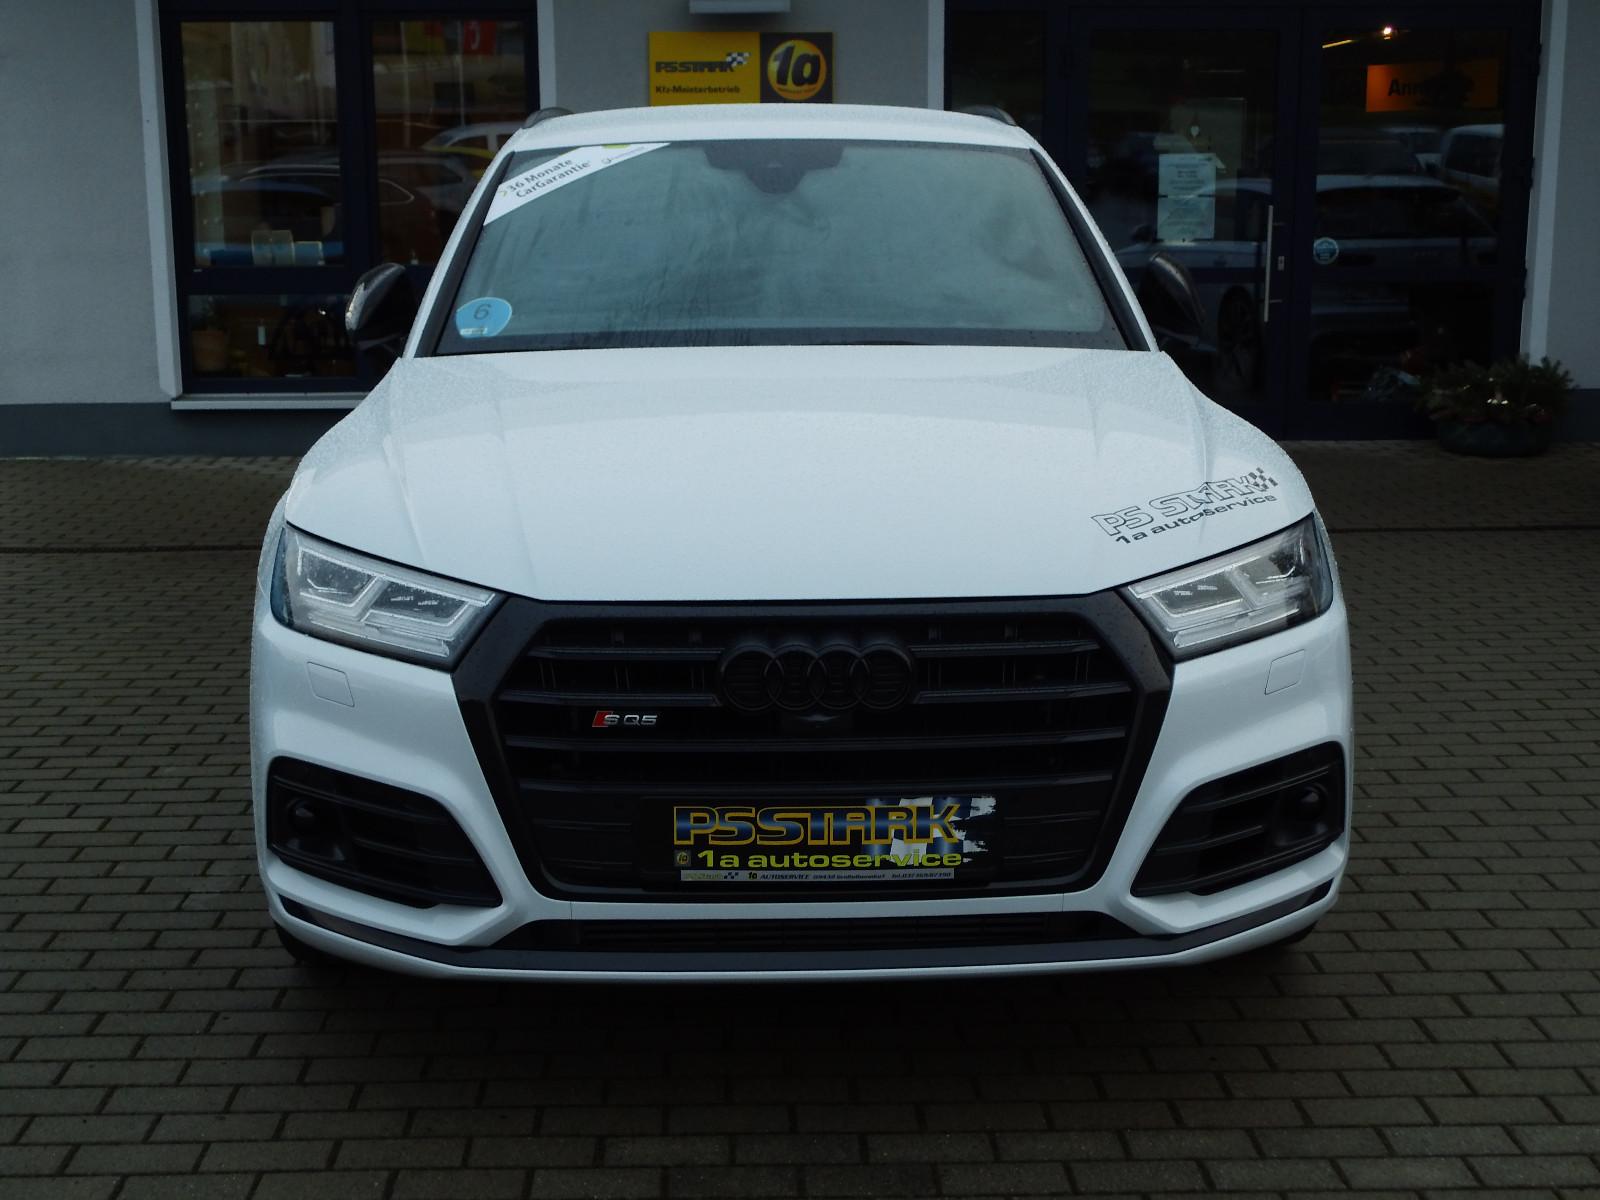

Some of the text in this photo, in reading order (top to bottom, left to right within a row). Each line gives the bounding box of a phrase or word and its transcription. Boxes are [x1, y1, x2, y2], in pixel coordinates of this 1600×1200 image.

[774, 45, 820, 87] 1a
[655, 85, 740, 94] Kfz-Meisterbetrieb
[507, 159, 573, 194] 36 Monate
[516, 162, 591, 199] CarGarantie
[473, 303, 492, 320] 6
[1091, 506, 1154, 536] PS
[1116, 495, 1278, 544] 1a autoservice
[698, 850, 963, 868] 1a autoservice
